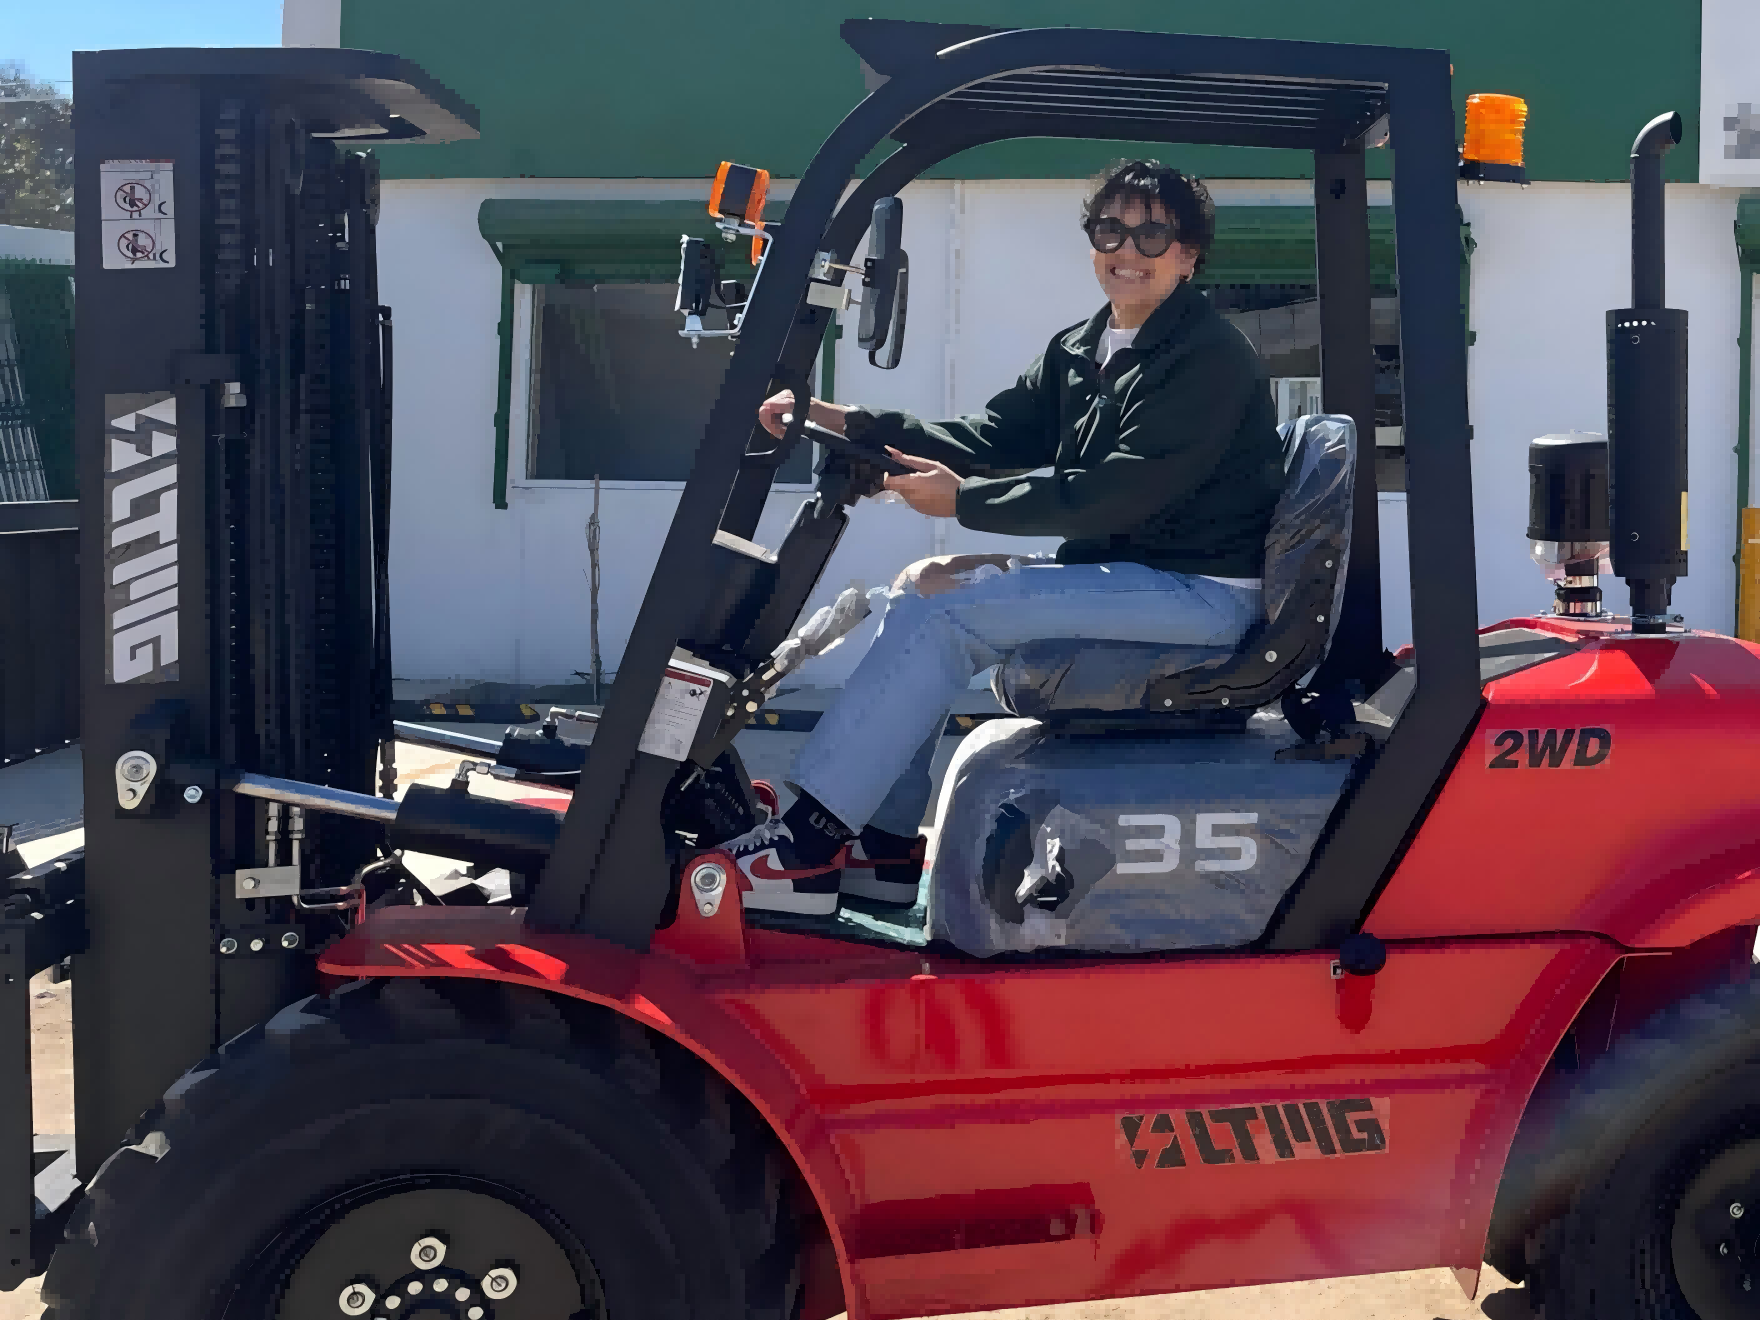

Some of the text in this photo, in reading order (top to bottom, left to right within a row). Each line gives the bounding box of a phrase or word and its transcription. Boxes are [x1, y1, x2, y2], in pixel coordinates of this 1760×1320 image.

[112, 463, 179, 684] LTMG
[1488, 726, 1613, 769] 2WD
[1116, 812, 1259, 875] 35
[1185, 1097, 1387, 1165] LTMG
